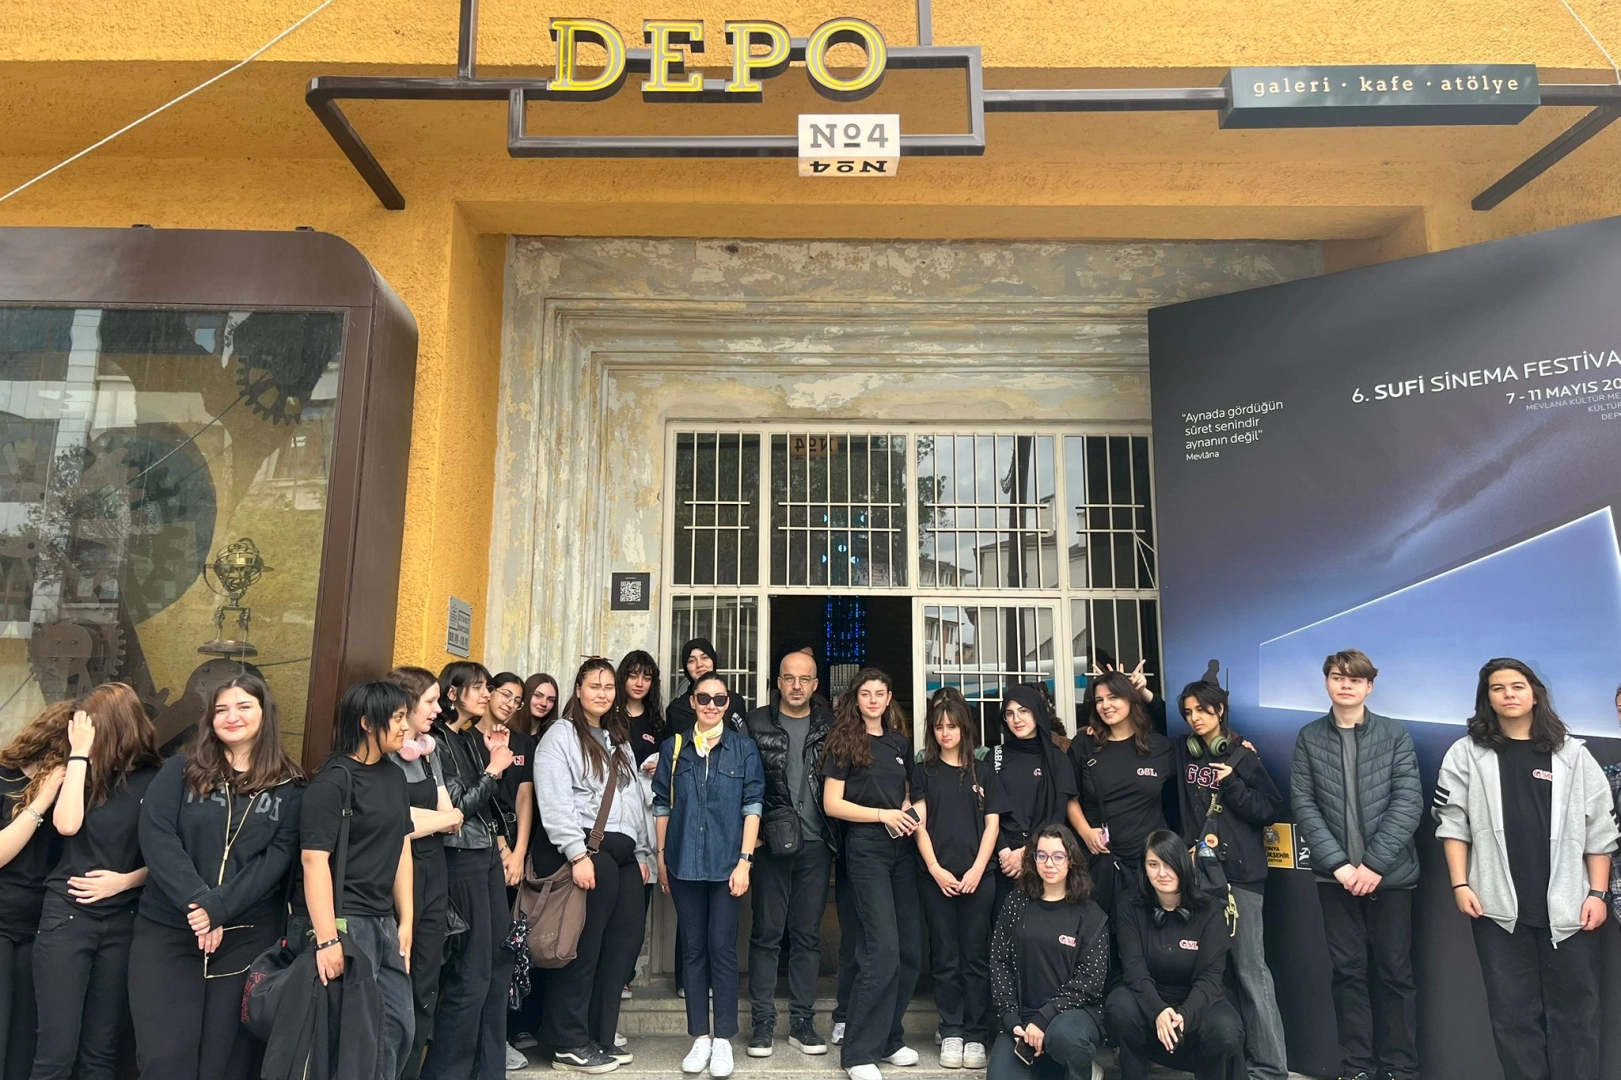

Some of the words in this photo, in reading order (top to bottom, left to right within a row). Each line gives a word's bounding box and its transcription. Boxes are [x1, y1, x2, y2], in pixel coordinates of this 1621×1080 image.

[549, 17, 888, 96] DEPO
[1253, 76, 1331, 97] galeri
[1359, 75, 1414, 92] kafe
[1441, 75, 1519, 95] atölye
[1352, 387, 1370, 404] 6.
[1374, 375, 1425, 400] SUFİ
[1430, 365, 1519, 392] SİNEMA
[1505, 392, 1516, 405] 7
[1528, 389, 1542, 401] 11
[1546, 381, 1599, 399] MAYIS
[1227, 400, 1284, 419] gördüğün
[1525, 400, 1568, 411] MEVLANA
[1569, 393, 1606, 405] KÜLTÜR
[1601, 411, 1621, 421] DEP
[1184, 423, 1212, 436] sûret
[1215, 417, 1260, 432] senindir
[1185, 437, 1228, 451] aynanın
[1185, 450, 1220, 461] Mevlâna
[1136, 767, 1158, 777] GSL
